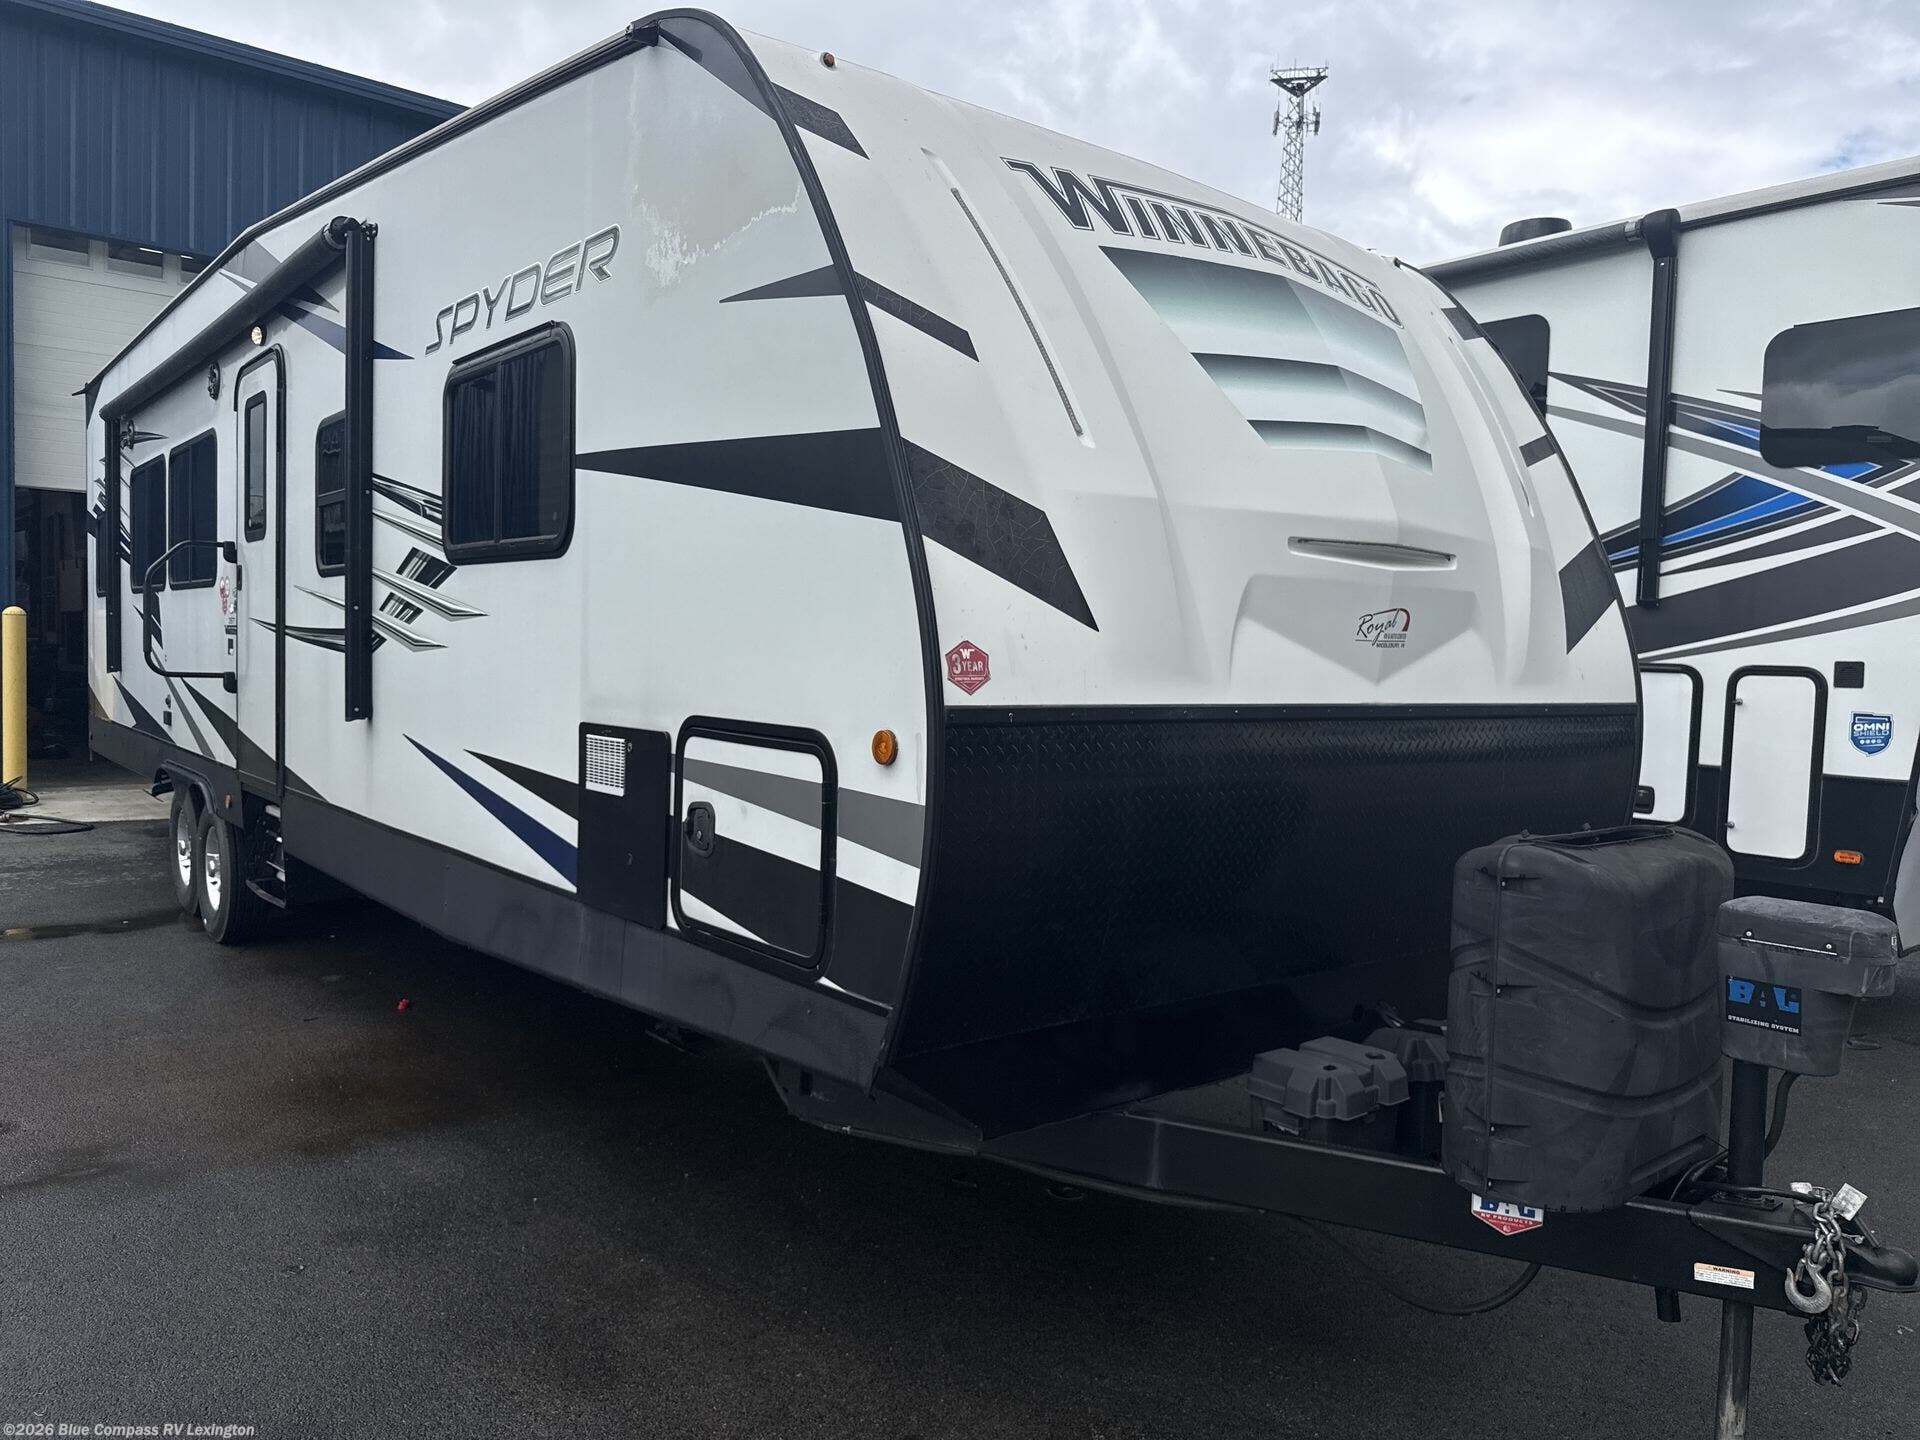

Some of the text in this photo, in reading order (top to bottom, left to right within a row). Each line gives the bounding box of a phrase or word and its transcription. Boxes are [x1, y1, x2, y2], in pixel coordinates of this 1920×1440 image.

[1000, 157, 1404, 329] WINNEBAGO
[425, 223, 621, 356] SPYDER
[1356, 608, 1400, 646] Royal
[951, 653, 984, 675] 3 YEAR
[1853, 722, 1890, 731] OMNI
[1728, 978, 1800, 1014] BAL
[1728, 1014, 1800, 1034] STABILIZING SYSTEM
[1493, 1214, 1534, 1225] PRODUCTS
[1713, 1266, 1741, 1275] WARNING
